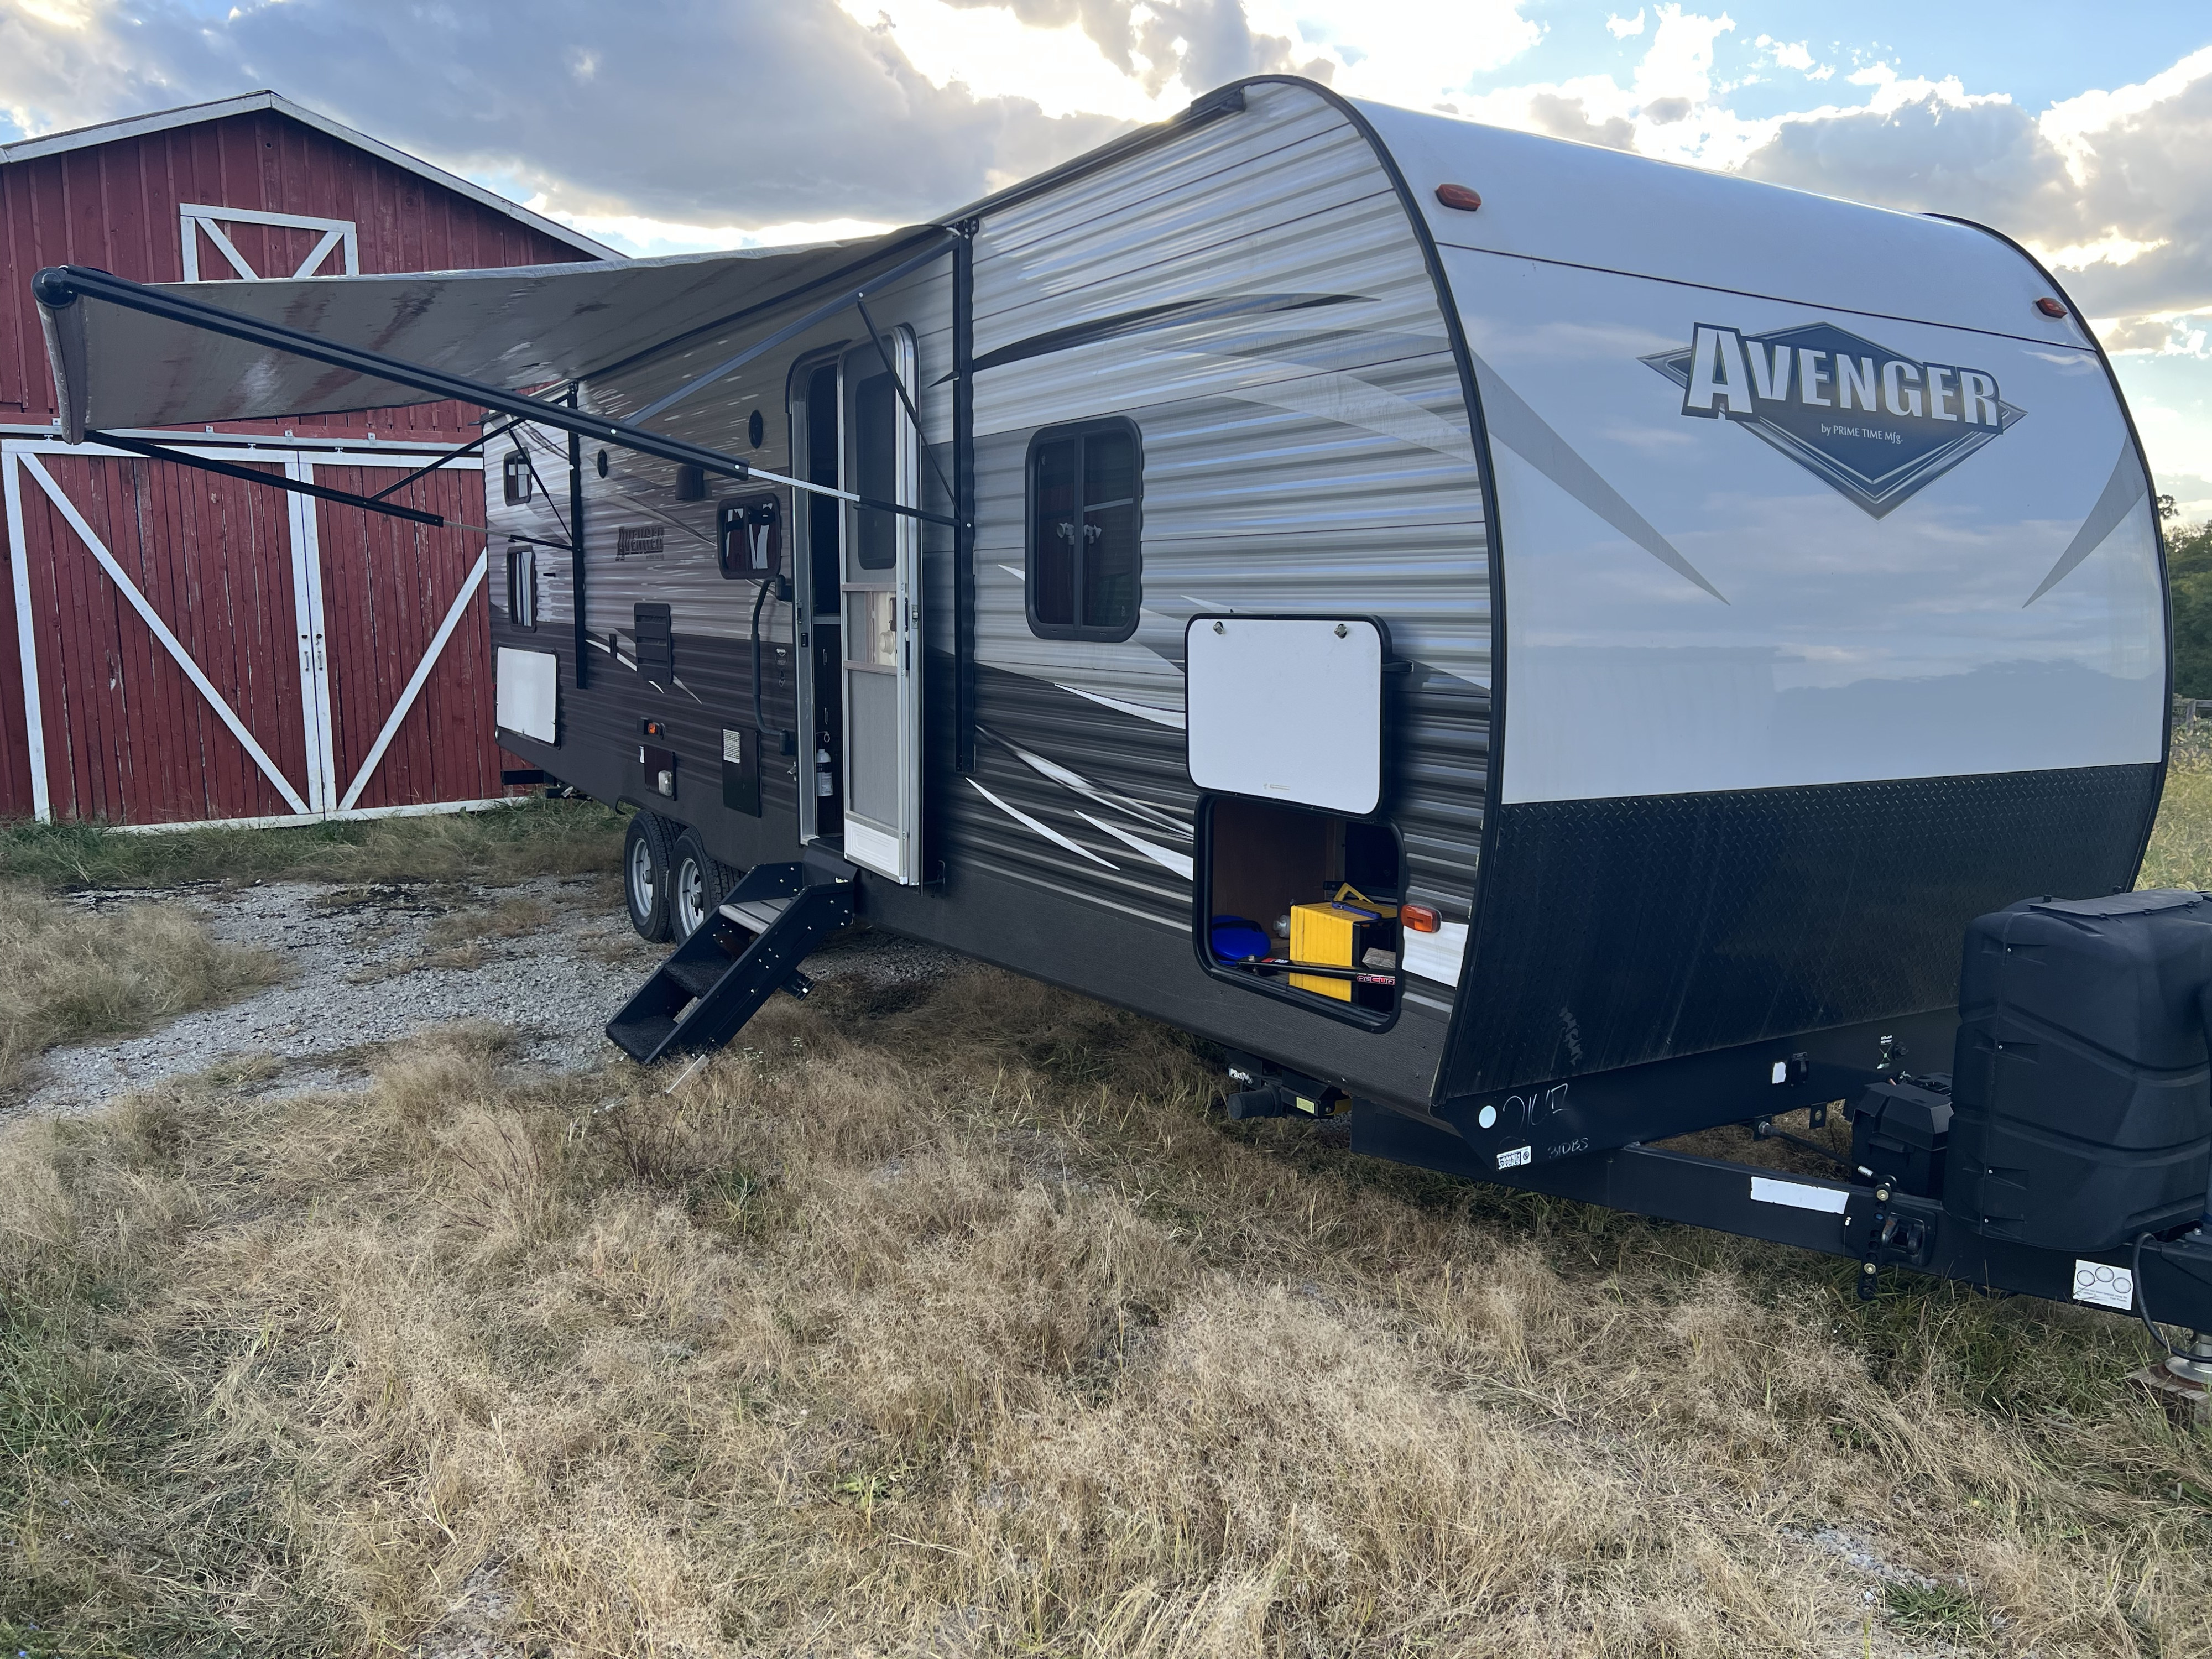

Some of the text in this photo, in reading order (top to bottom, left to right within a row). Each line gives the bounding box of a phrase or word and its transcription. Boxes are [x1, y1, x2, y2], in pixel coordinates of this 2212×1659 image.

[1686, 325, 2000, 428] AVENGER
[1821, 423, 1903, 444] by PRIME TIME Mfg.
[615, 525, 665, 561] AVENGER
[1357, 975, 1395, 985] RECUR
